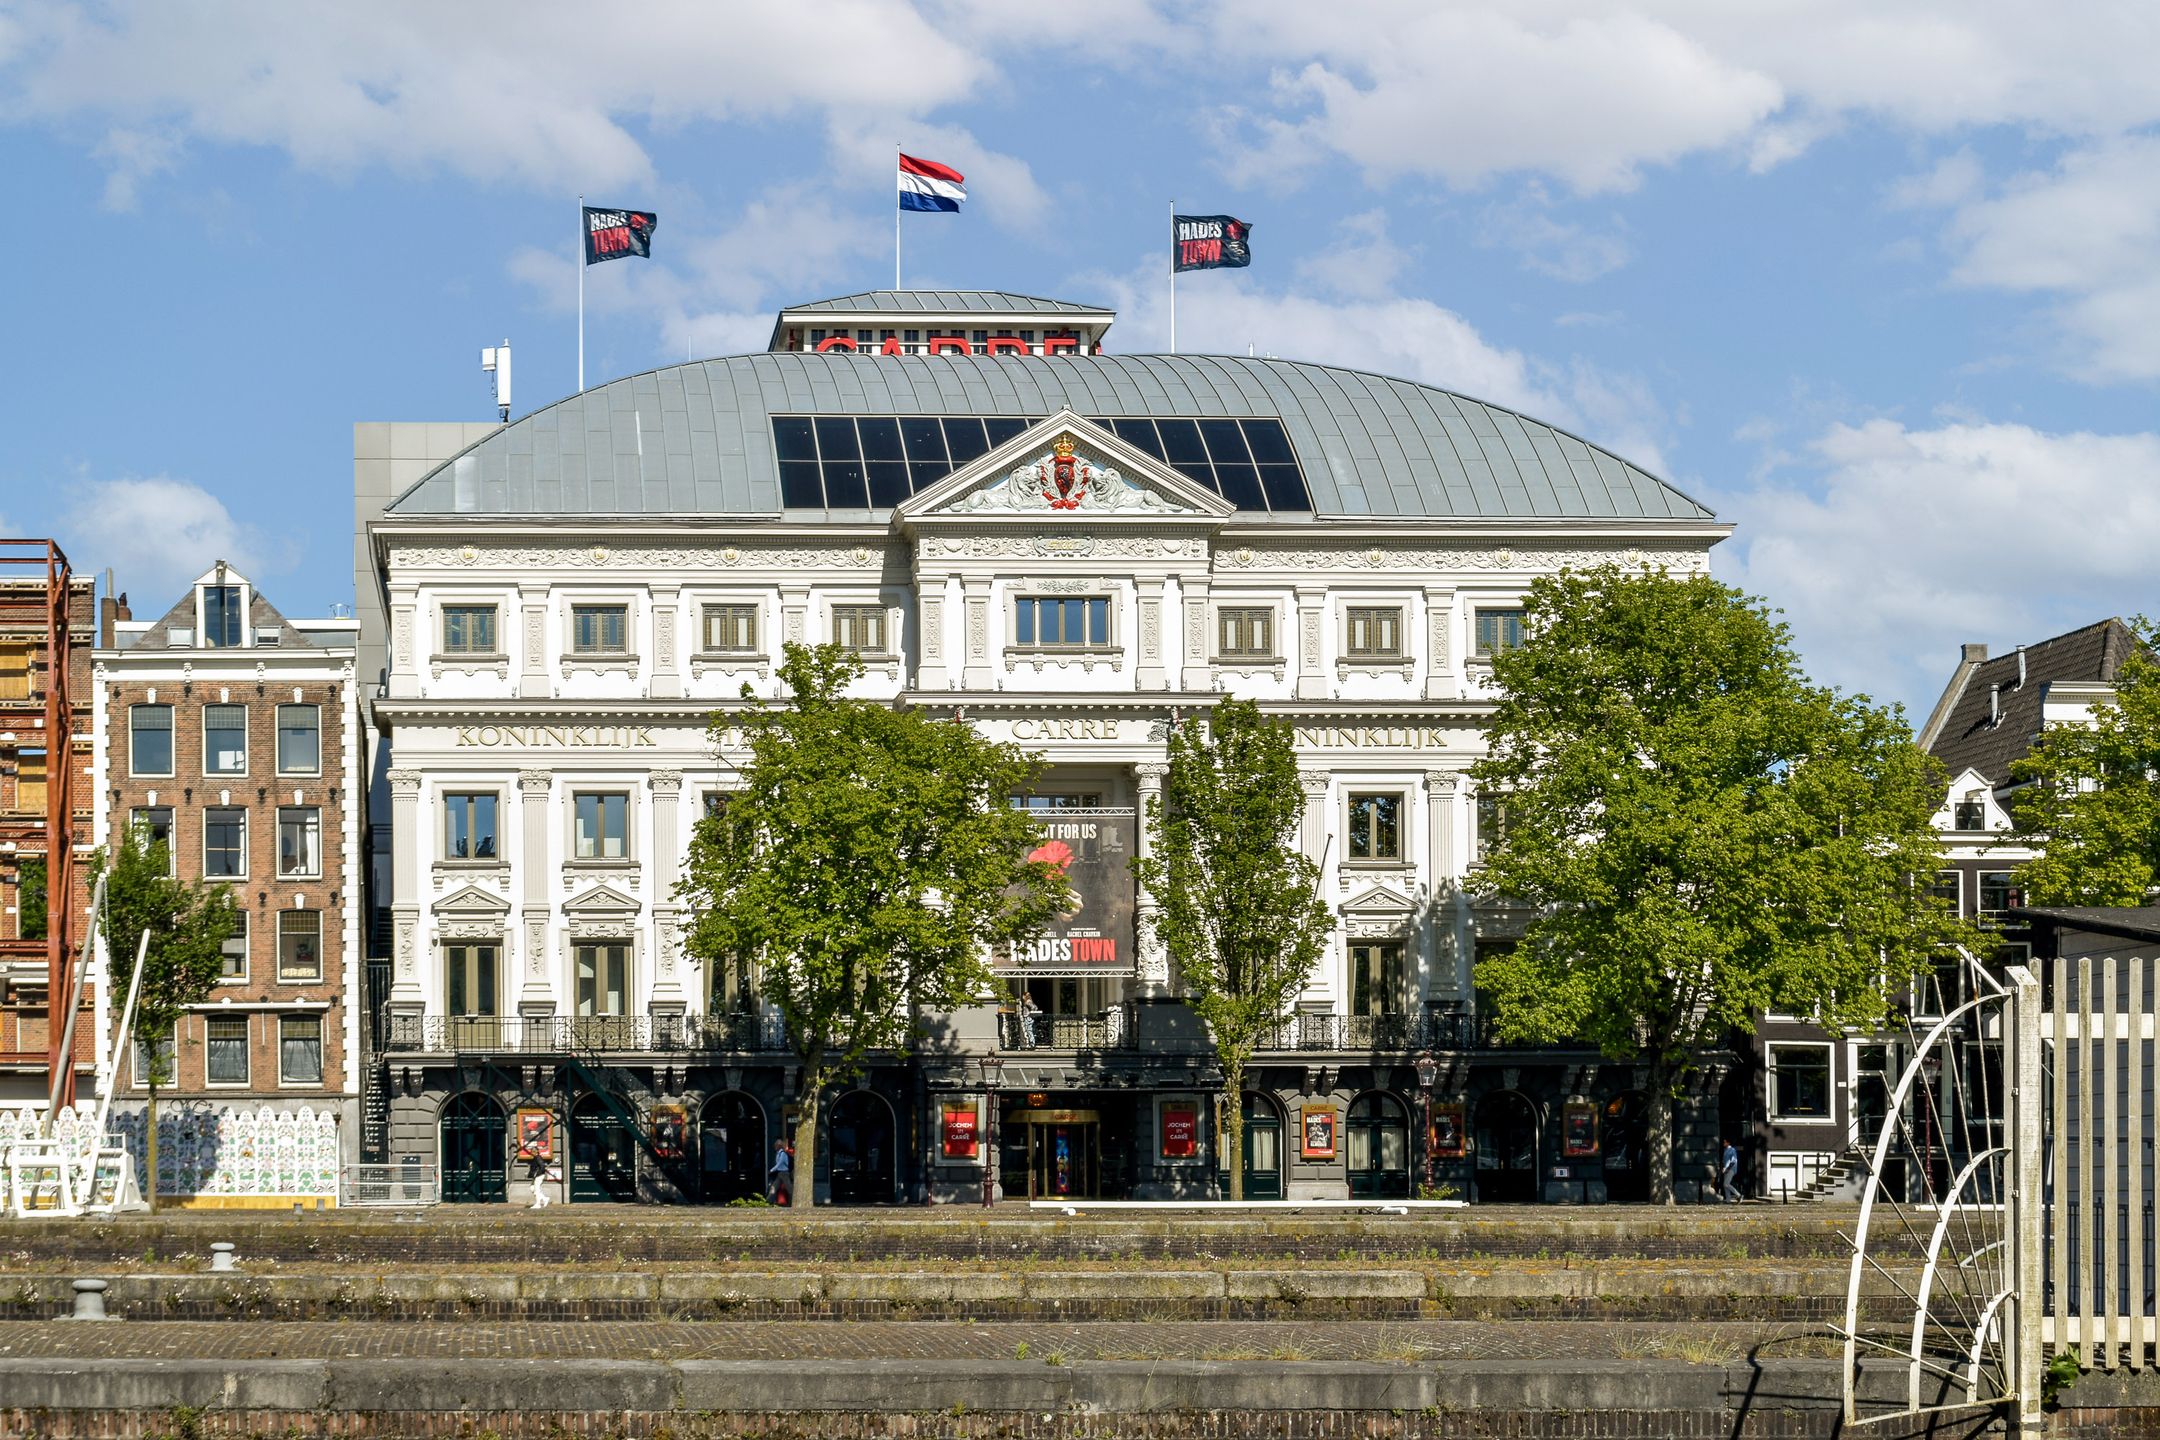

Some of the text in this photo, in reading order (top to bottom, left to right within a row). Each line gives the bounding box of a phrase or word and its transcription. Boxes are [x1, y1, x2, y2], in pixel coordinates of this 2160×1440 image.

[1179, 222, 1222, 241] HADES
[1179, 239, 1222, 265] TOWN
[456, 726, 656, 748] KONINKLIJK
[1012, 719, 1119, 740] CARRE
[1294, 726, 1448, 750] NINKLIJK
[1057, 824, 1079, 839] FOR
[1081, 824, 1097, 839] US
